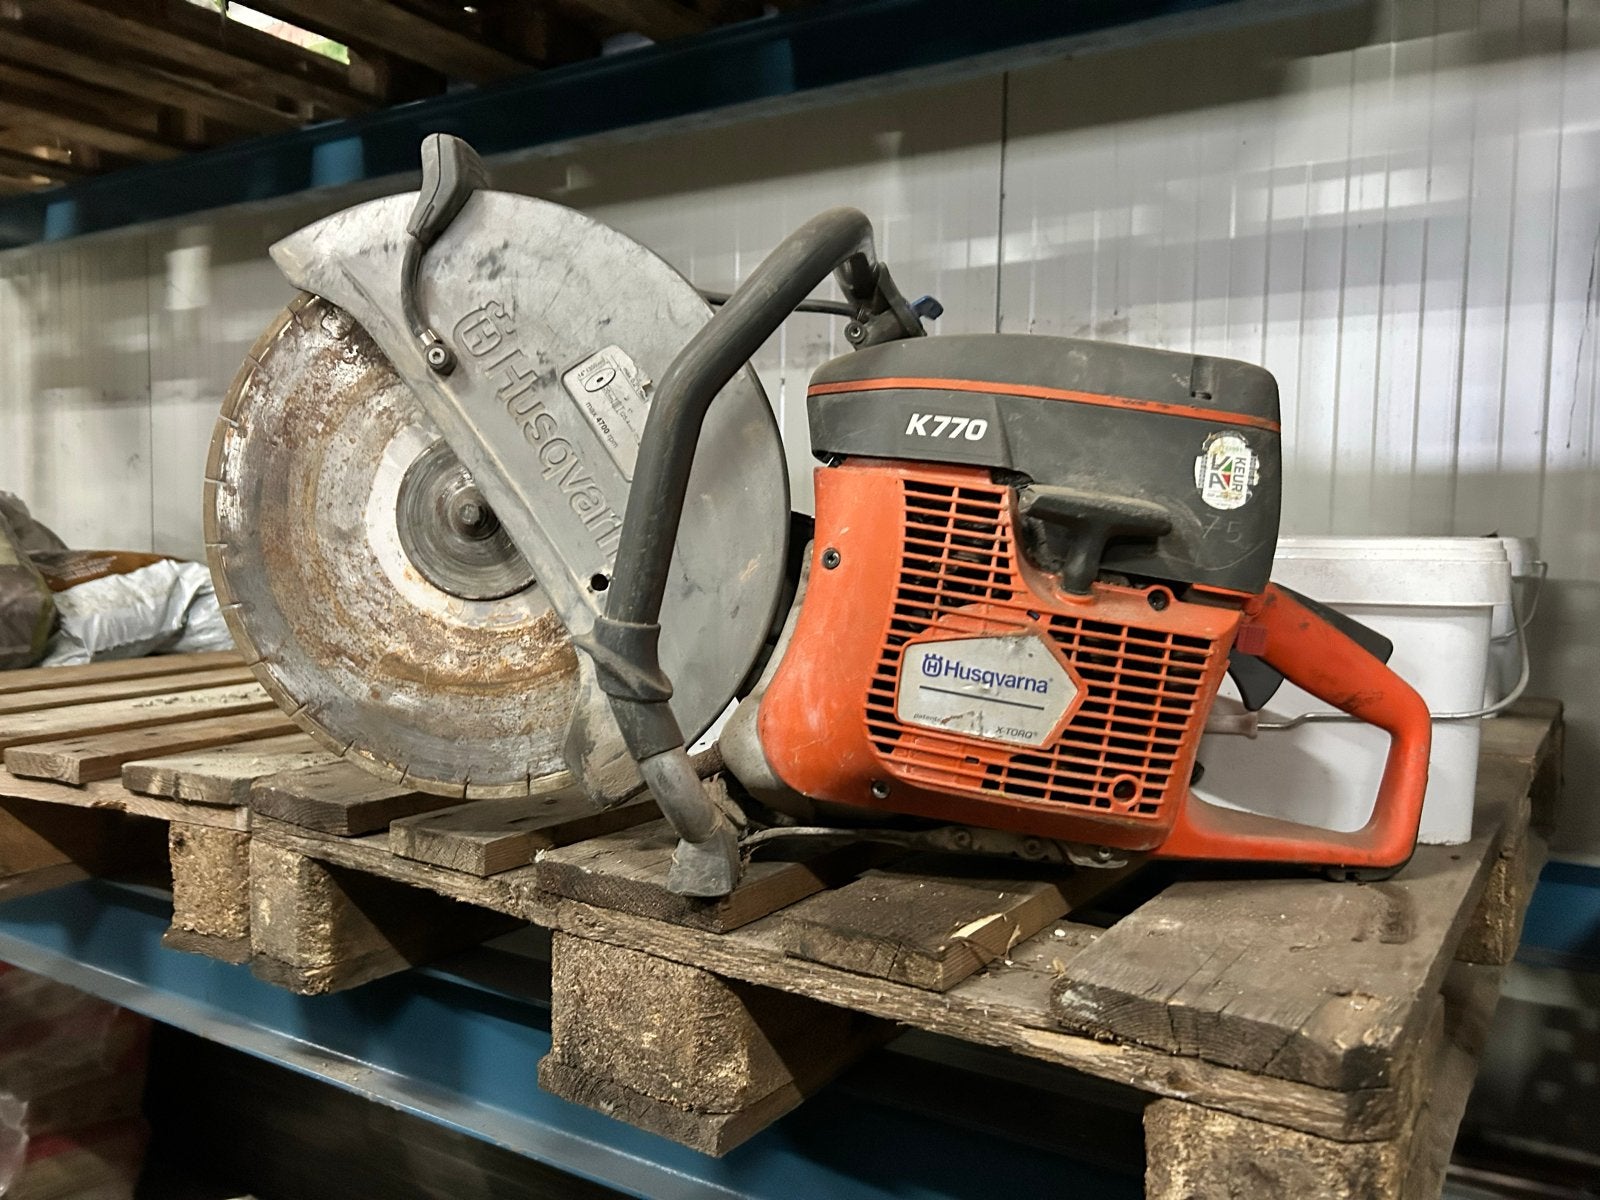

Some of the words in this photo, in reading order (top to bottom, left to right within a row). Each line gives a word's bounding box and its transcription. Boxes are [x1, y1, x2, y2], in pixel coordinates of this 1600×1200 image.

[585, 401, 597, 417] max
[596, 416, 610, 434] 4700
[606, 433, 618, 448] rpm
[905, 413, 988, 441] K770
[485, 348, 624, 562] Husqvarn
[1231, 456, 1247, 493] KEUR
[944, 660, 1048, 694] Husqvarna
